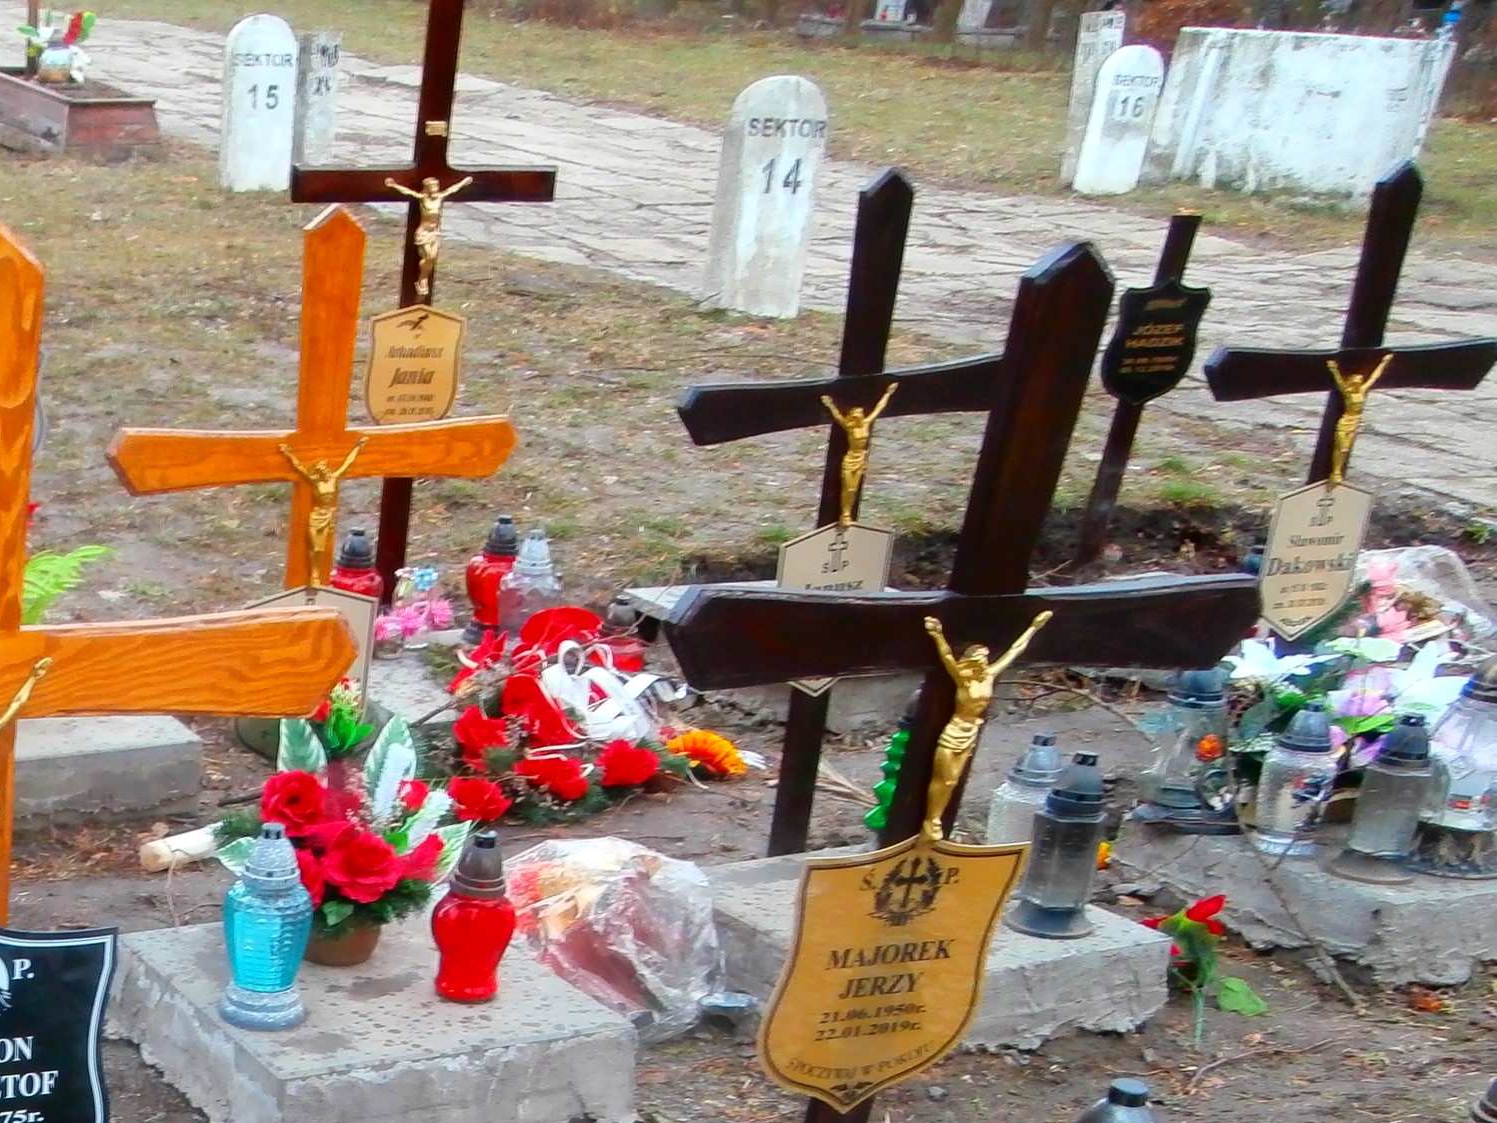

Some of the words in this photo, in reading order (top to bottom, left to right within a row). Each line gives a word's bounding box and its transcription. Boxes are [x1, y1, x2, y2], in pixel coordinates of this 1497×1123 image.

[232, 53, 295, 67] SEKTOR
[247, 83, 280, 110] 15
[1119, 95, 1145, 118] 16
[748, 118, 827, 138] SEKTOR
[762, 158, 803, 194] 14
[824, 938, 956, 971] MAJOREK
[12, 958, 35, 981] P.
[838, 971, 925, 1000] JERZY
